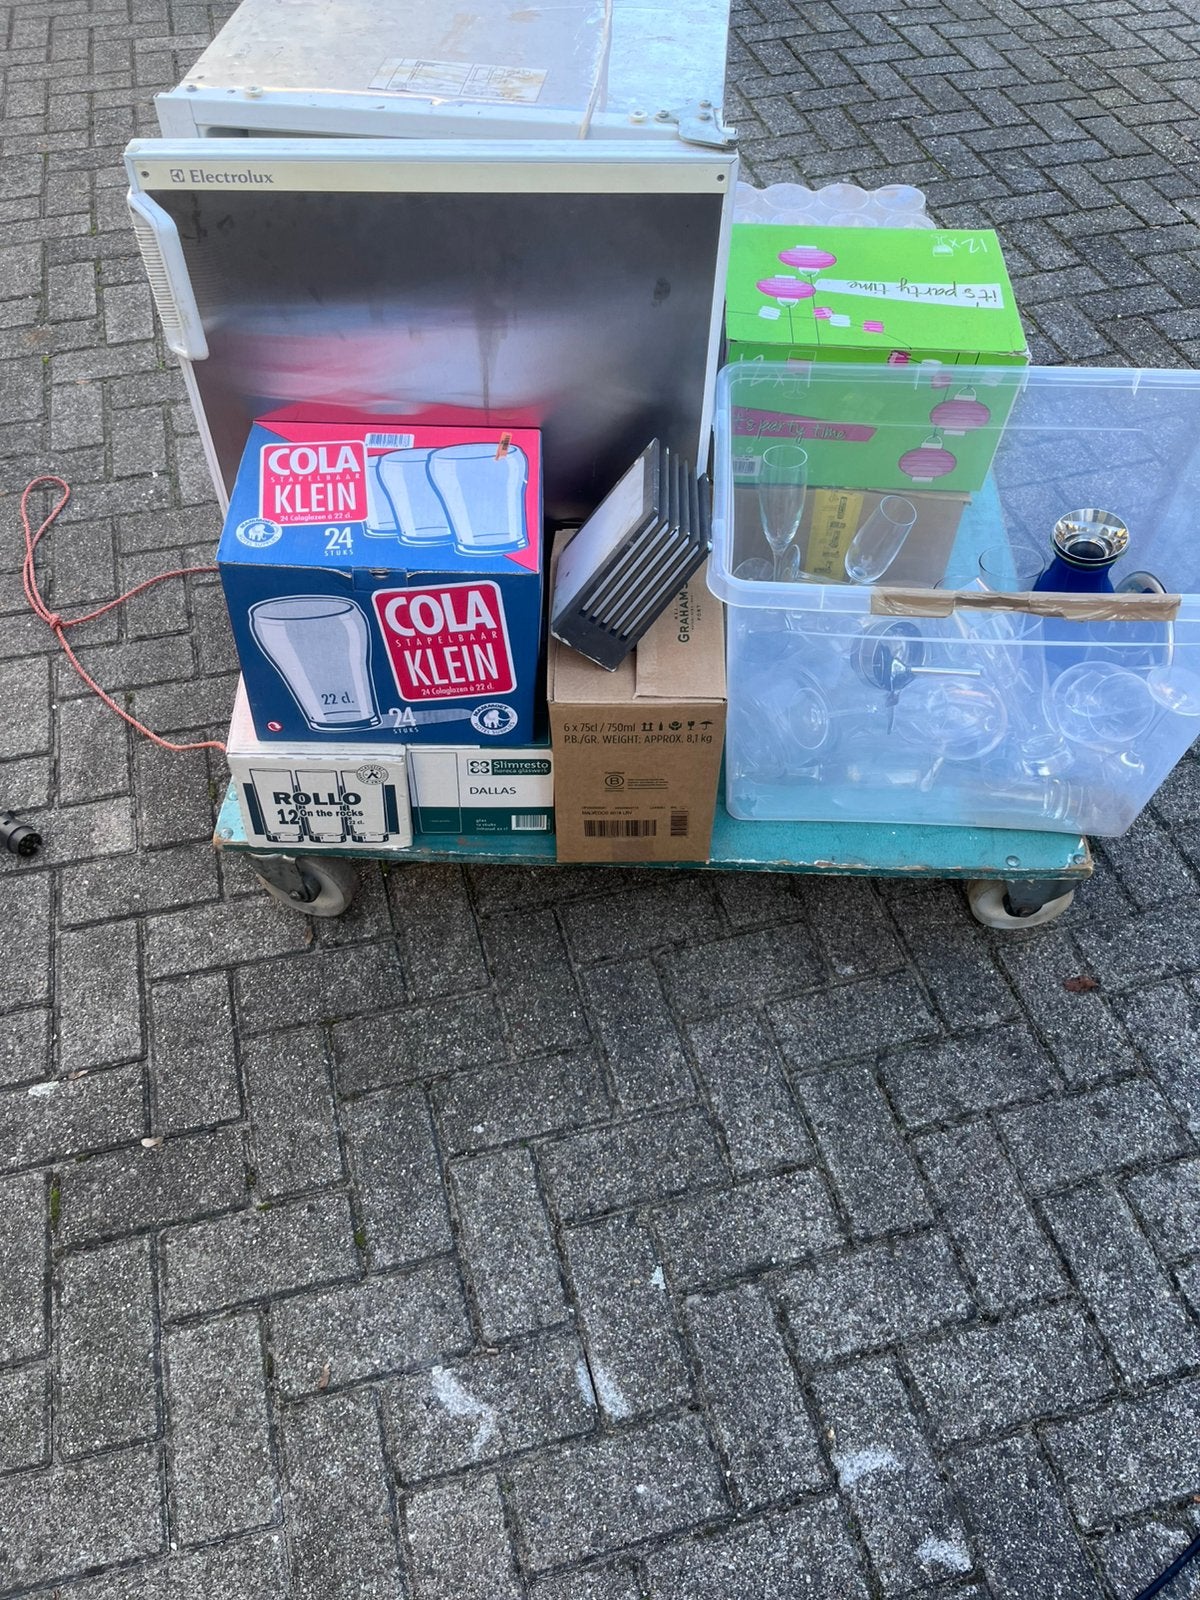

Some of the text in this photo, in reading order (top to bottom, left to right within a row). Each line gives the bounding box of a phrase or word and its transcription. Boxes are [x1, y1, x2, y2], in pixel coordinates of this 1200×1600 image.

[189, 169, 274, 184] Electrolux
[847, 277, 997, 308] it's party time
[755, 419, 806, 445] party
[813, 423, 847, 440] time
[268, 446, 361, 476] COLA
[270, 473, 361, 483] STAPELBAAR
[275, 482, 357, 514] KLEIN
[290, 514, 327, 522] Colaglazen
[324, 526, 353, 550] 24
[385, 590, 497, 637] COLA
[395, 631, 498, 648] STAPELBAAR
[403, 643, 499, 687] KLEIN
[421, 688, 430, 696] 24
[432, 686, 468, 695] Colaglazen
[475, 683, 485, 691] 22
[487, 682, 495, 690] cl.
[321, 691, 355, 705] 22 cl.
[388, 707, 416, 728] 24
[563, 723, 570, 732] 6
[580, 723, 598, 732] 75cl
[608, 722, 636, 732] 750ml
[603, 735, 641, 744] WEIGHT:
[644, 735, 683, 744] APPROX.
[687, 734, 698, 744] 8,1
[701, 734, 713, 744] kg
[493, 761, 549, 769] Slimresto
[273, 792, 362, 805] ROLLO
[469, 787, 517, 795] DALLAS
[277, 808, 364, 825] 12 On the rocks
